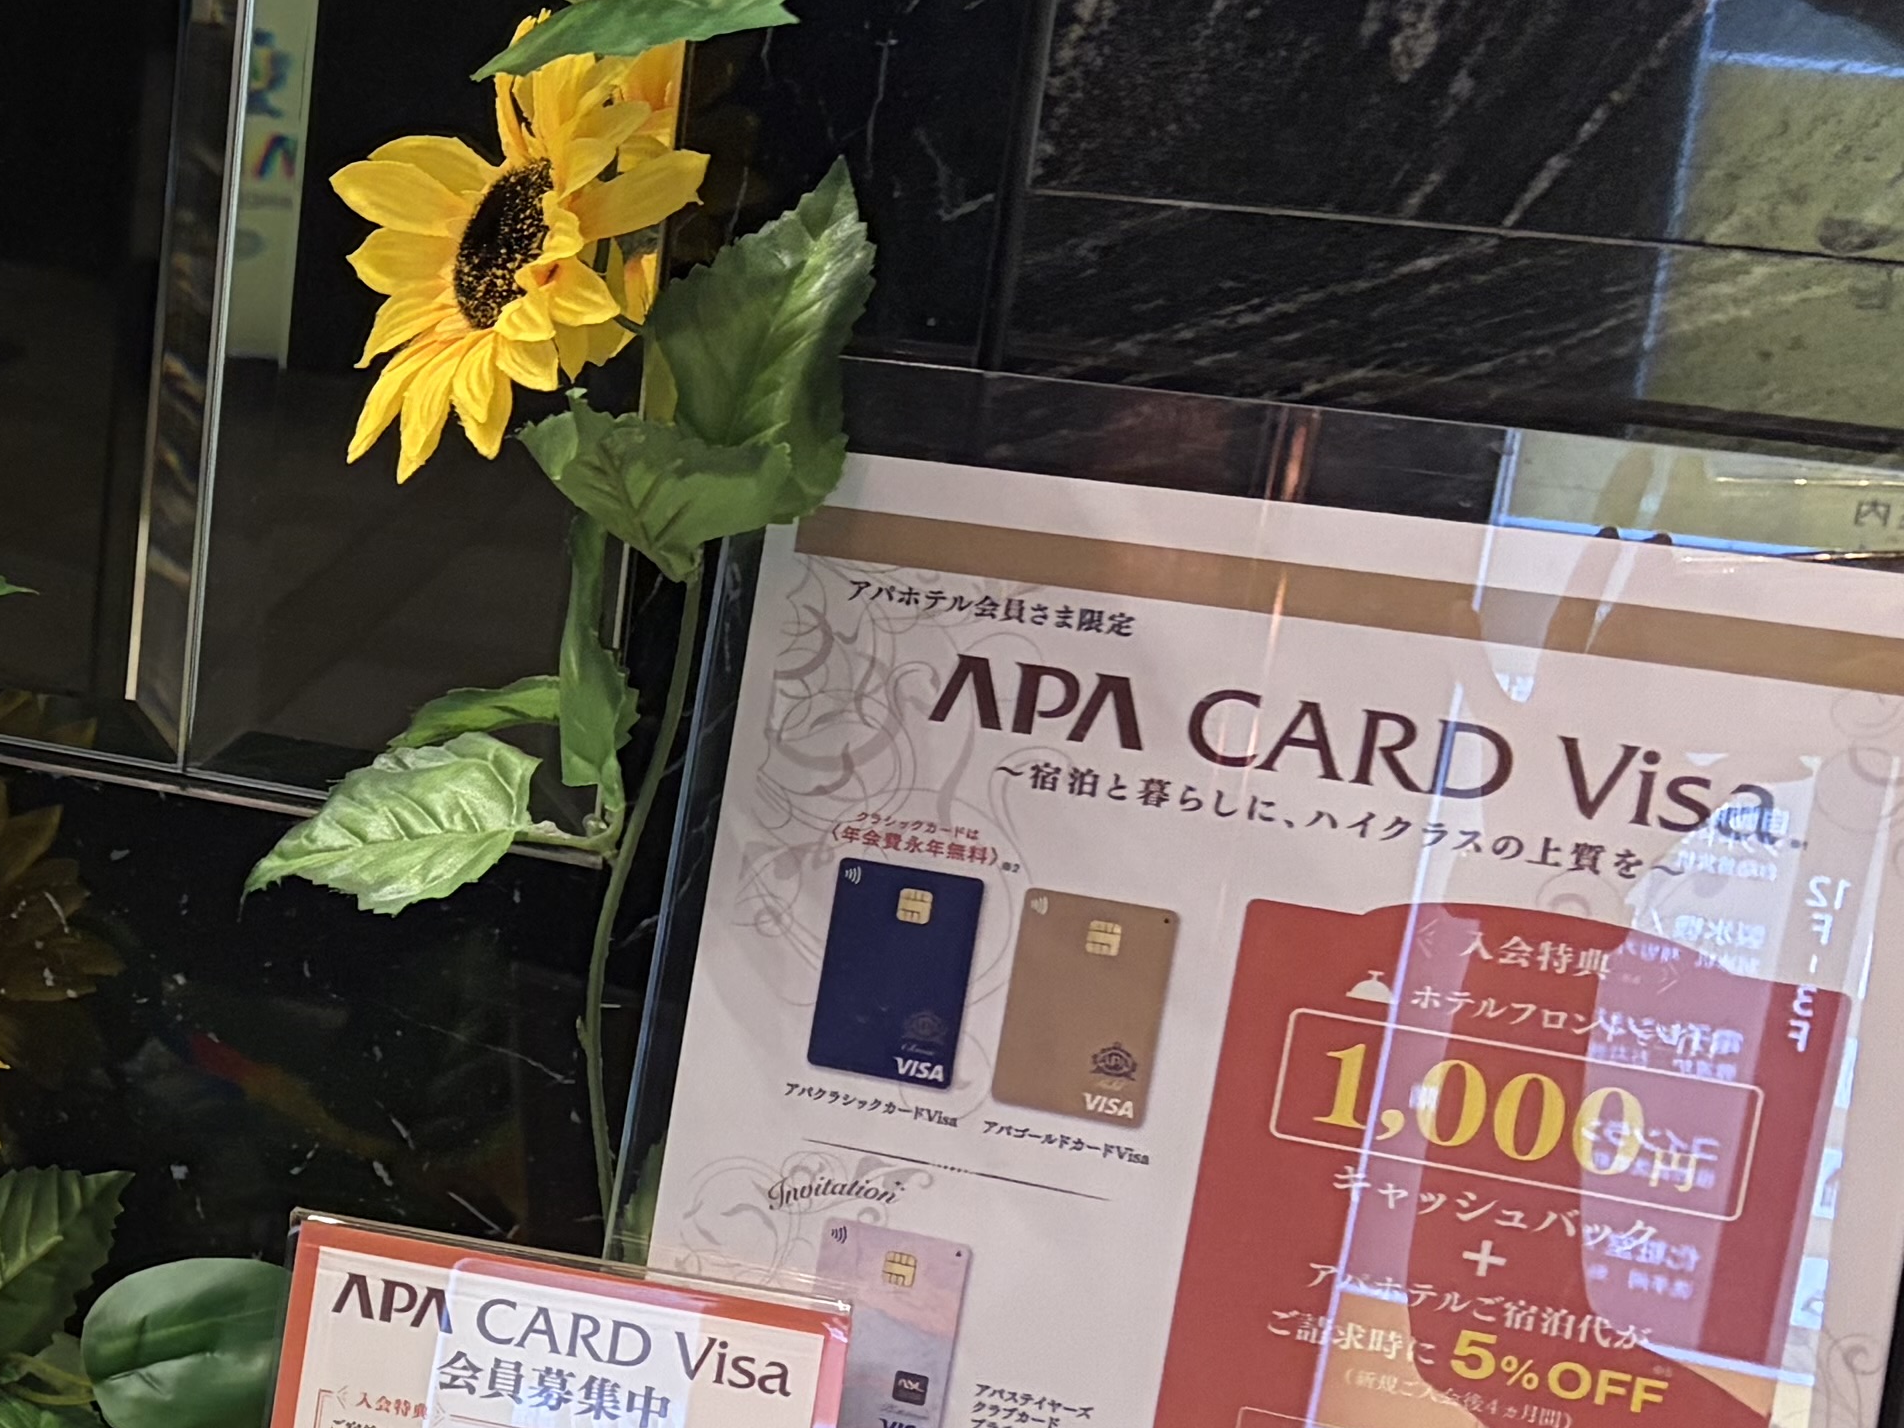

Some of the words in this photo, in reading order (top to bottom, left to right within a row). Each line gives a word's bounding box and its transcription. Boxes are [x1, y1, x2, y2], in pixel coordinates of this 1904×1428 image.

[848, 579, 1136, 637] アパホテル会員さま限定
[929, 653, 1143, 751] APA
[1188, 688, 1513, 799] CARD
[1559, 734, 1778, 847] Visa
[856, 810, 980, 840] クラシックカードは
[1461, 932, 1613, 981] 入会特典
[894, 1056, 944, 1083] VISA
[784, 1082, 959, 1128] アパクラシックカードVisa
[984, 1120, 1150, 1165] アパゴールドカードVisa
[1082, 1091, 1134, 1119] VISA
[1312, 1042, 1698, 1193] 1,000円
[767, 1175, 900, 1212] Invitation
[1332, 1165, 1658, 1253] キャッシュバック
[1307, 1261, 1652, 1351] アパホテルご宿泊代が
[332, 1271, 455, 1335] APA
[476, 1297, 653, 1368] CARD
[674, 1331, 792, 1399] Visa
[355, 1391, 429, 1421] 入会特典
[974, 1383, 1095, 1421] アパステイヤーズ
